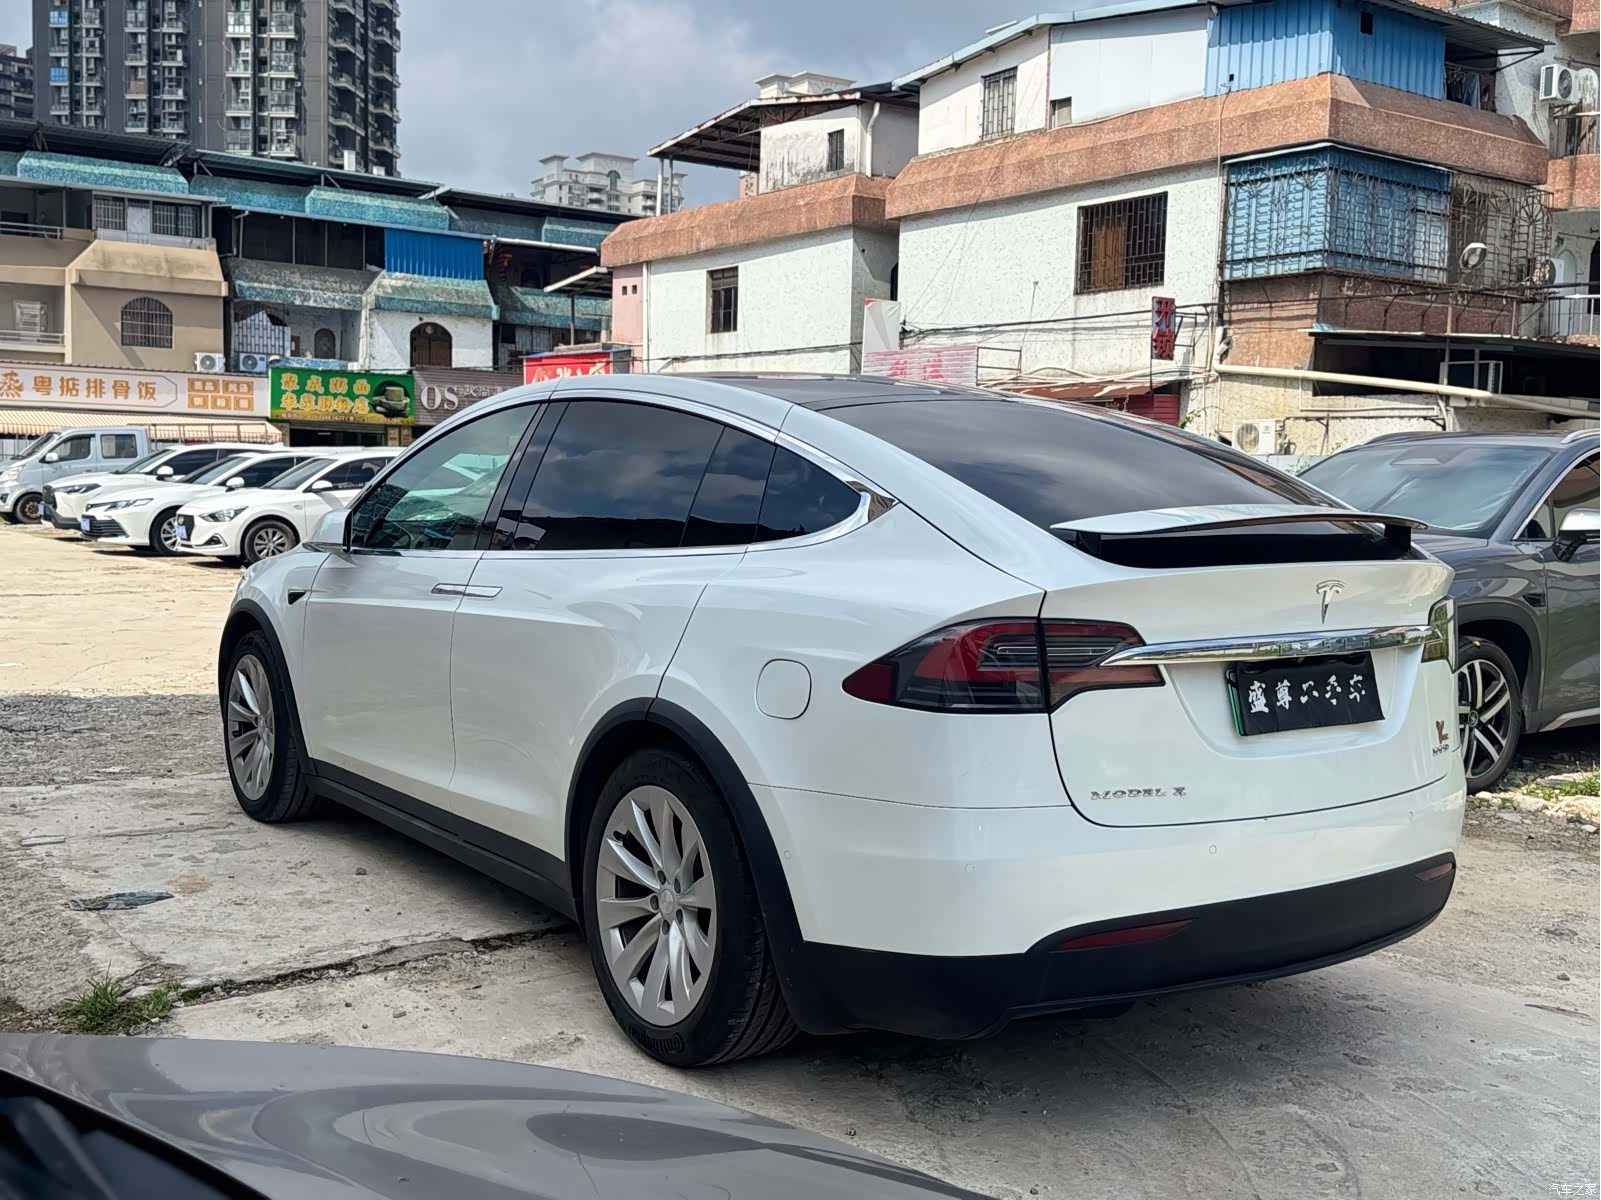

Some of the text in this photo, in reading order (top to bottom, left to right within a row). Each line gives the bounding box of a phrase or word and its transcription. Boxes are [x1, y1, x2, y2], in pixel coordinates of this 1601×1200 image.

[1153, 298, 1174, 358] 开锁
[420, 385, 459, 410] OS
[1090, 786, 1186, 800] MODEL X
